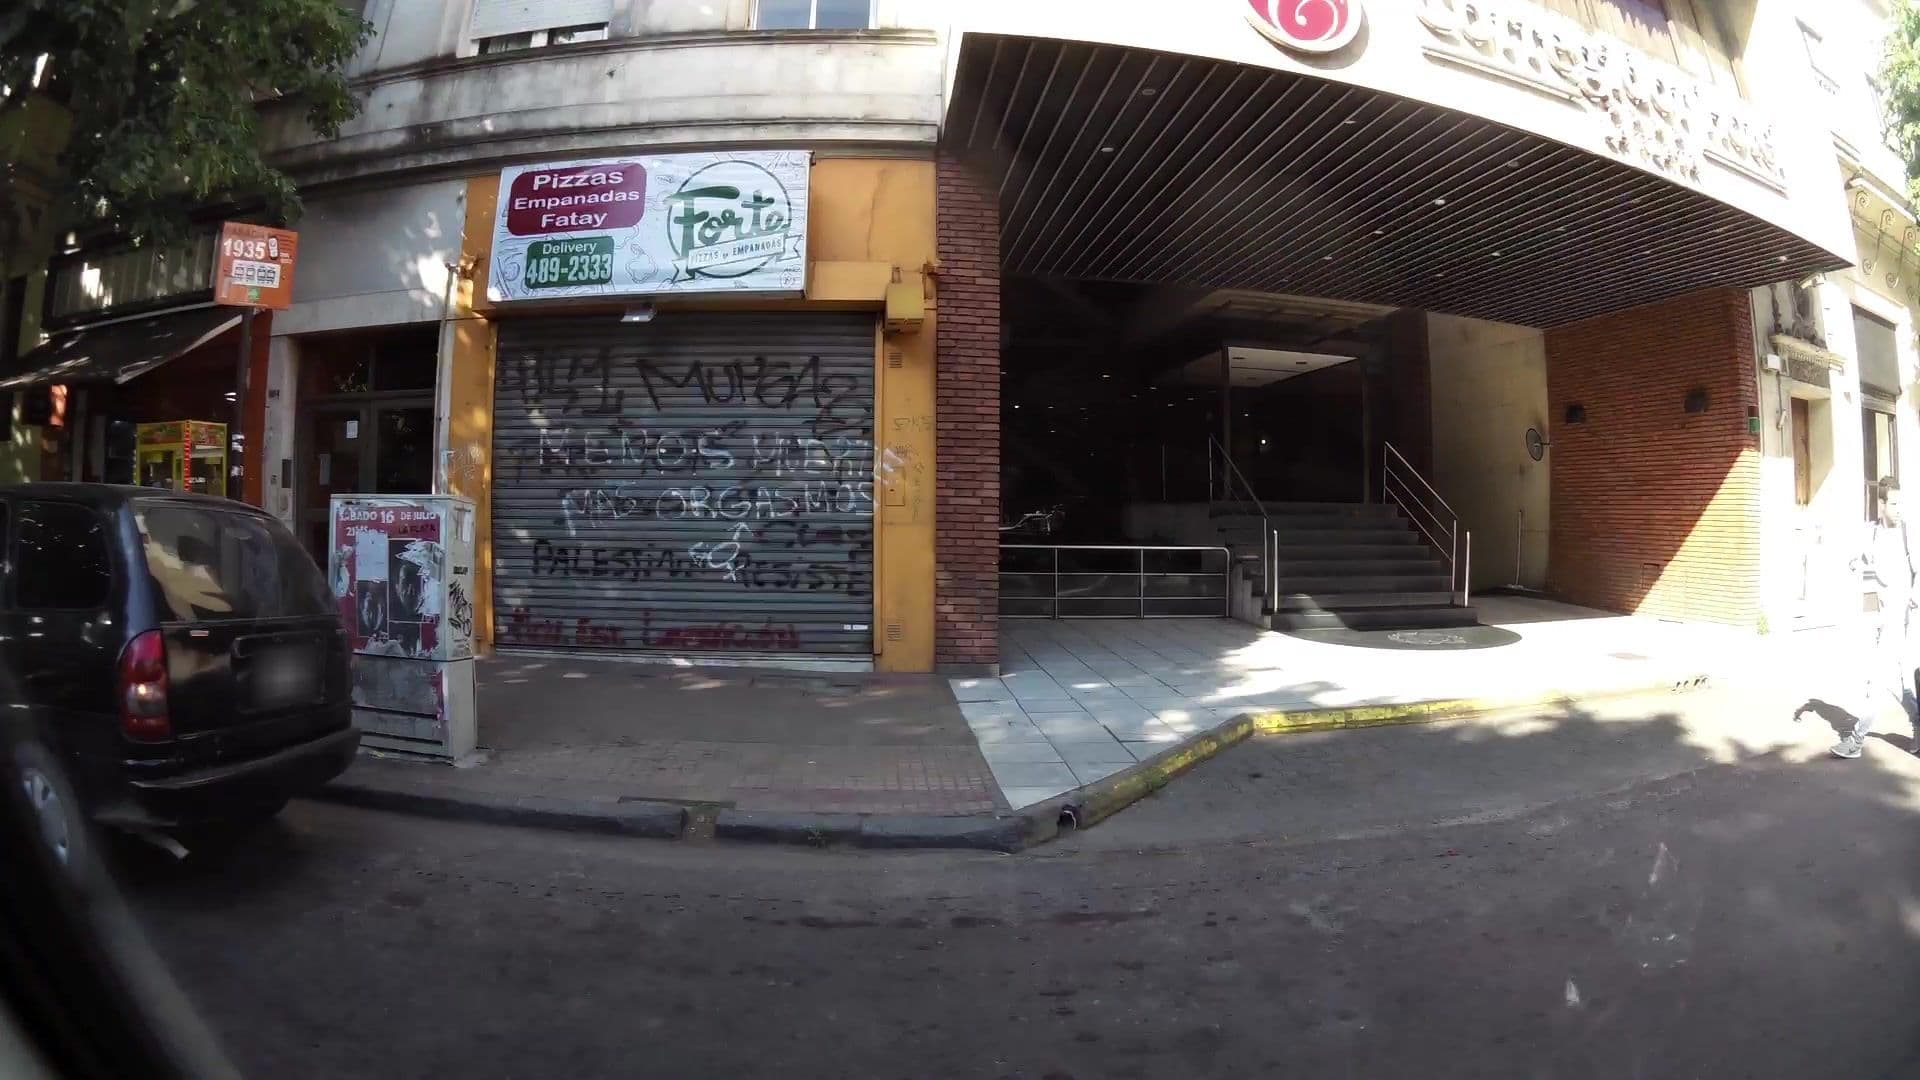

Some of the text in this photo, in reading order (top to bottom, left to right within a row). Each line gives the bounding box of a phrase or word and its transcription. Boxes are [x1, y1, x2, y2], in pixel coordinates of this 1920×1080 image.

[533, 169, 624, 190] Pizzas
[514, 189, 640, 211] Empanadas
[541, 210, 608, 229] Fatay
[663, 186, 790, 258] Forte
[223, 238, 267, 260] 1935
[543, 240, 597, 256] Delivery
[732, 239, 782, 257] EMPANADAS
[526, 254, 612, 284] 489-2333
[656, 481, 873, 521] ORGASMOS
[381, 510, 395, 524] 16
[400, 511, 411, 520] DE
[412, 511, 436, 521] JULIO
